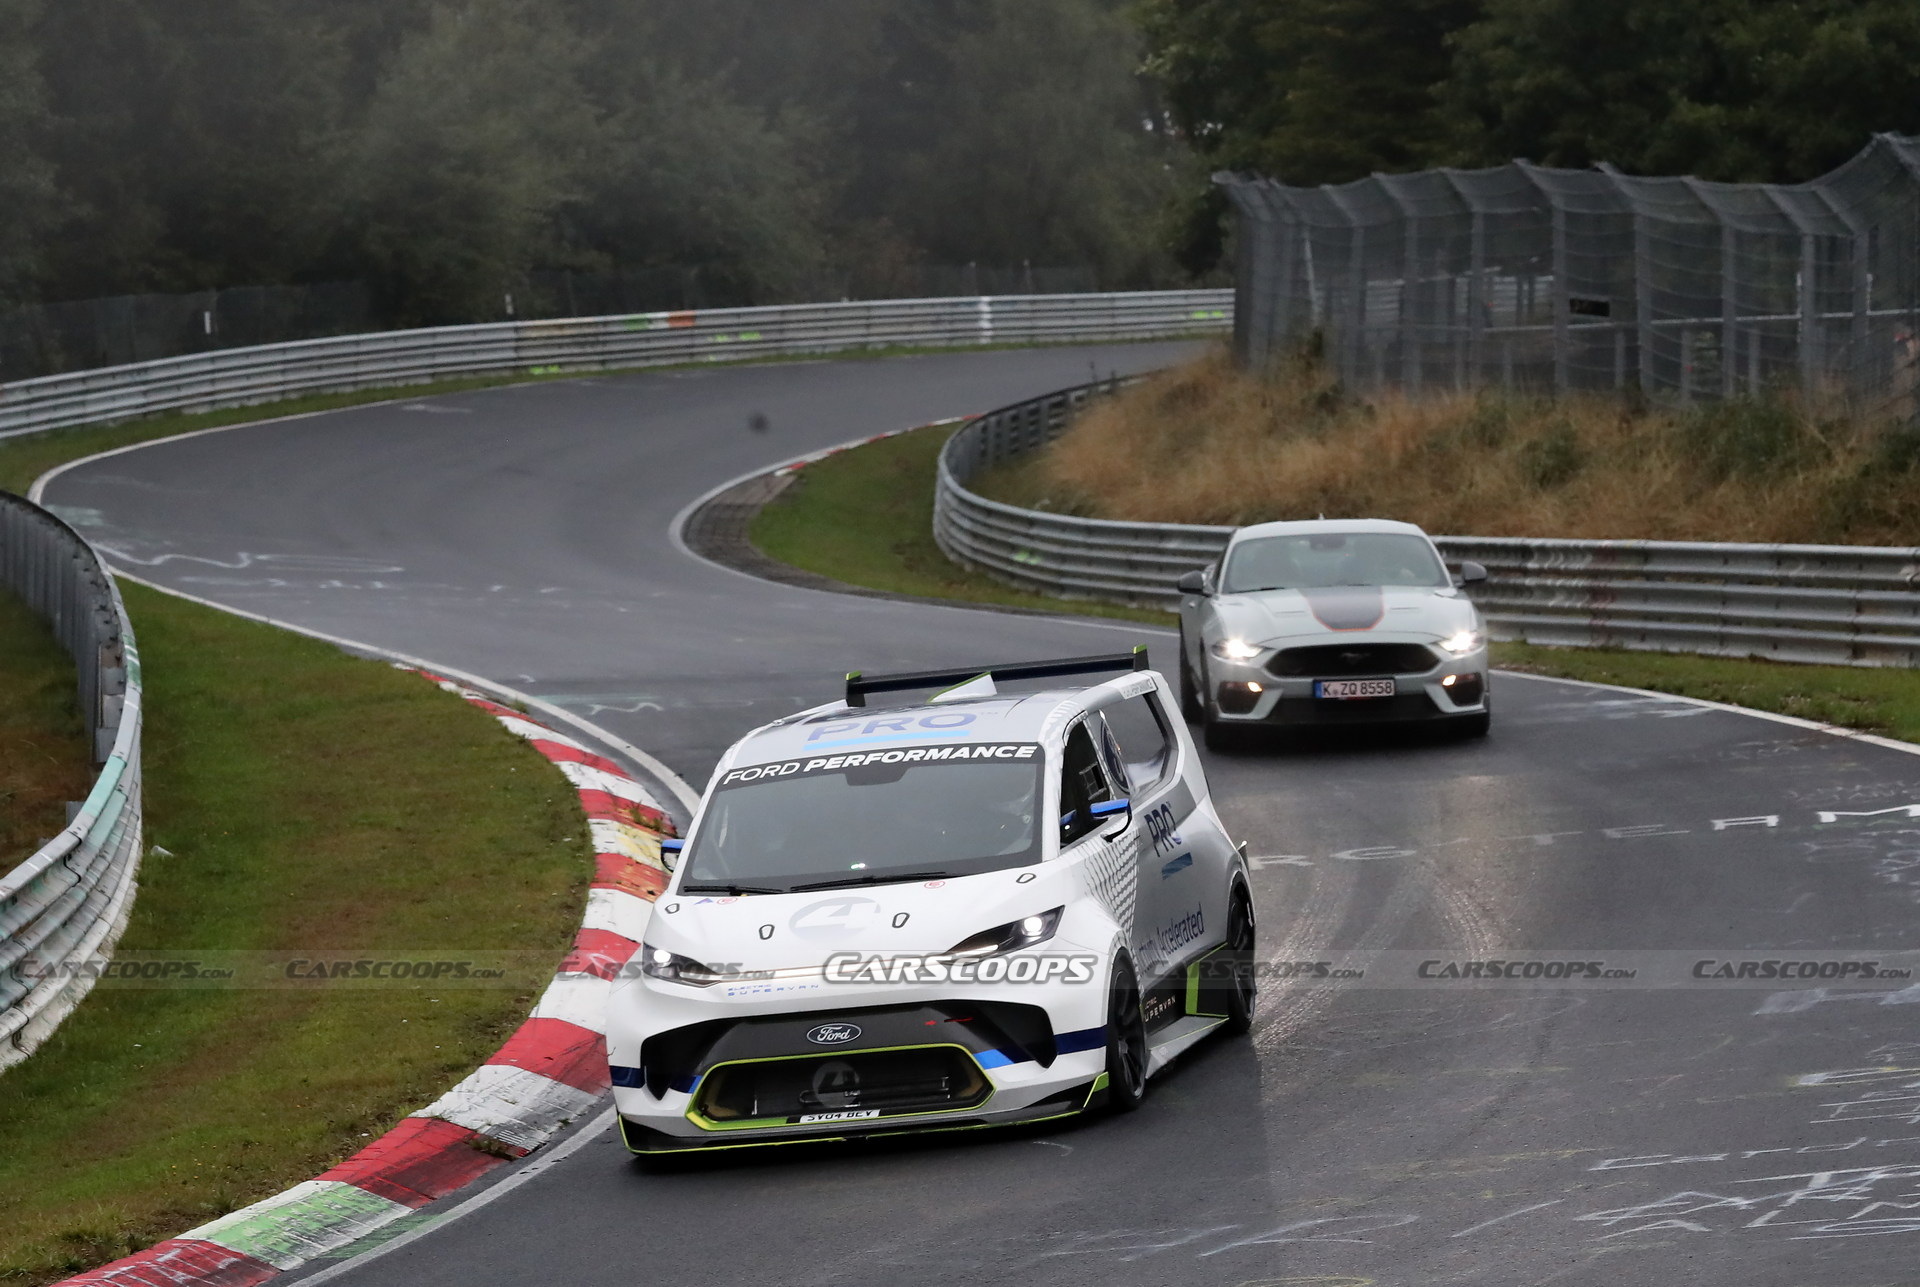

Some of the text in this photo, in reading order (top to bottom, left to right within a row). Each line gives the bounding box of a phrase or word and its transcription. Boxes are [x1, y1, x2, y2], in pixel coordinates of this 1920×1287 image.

[1323, 683, 1331, 696] K
[1360, 682, 1392, 695] 8558
[807, 712, 978, 742] PRO
[722, 745, 1038, 786] FORD PERFORMANCE
[1144, 803, 1182, 858] PRO
[727, 984, 819, 997] SUPERVAN
[1144, 995, 1176, 1022] UPERVAN
[817, 1026, 851, 1042] Ford
